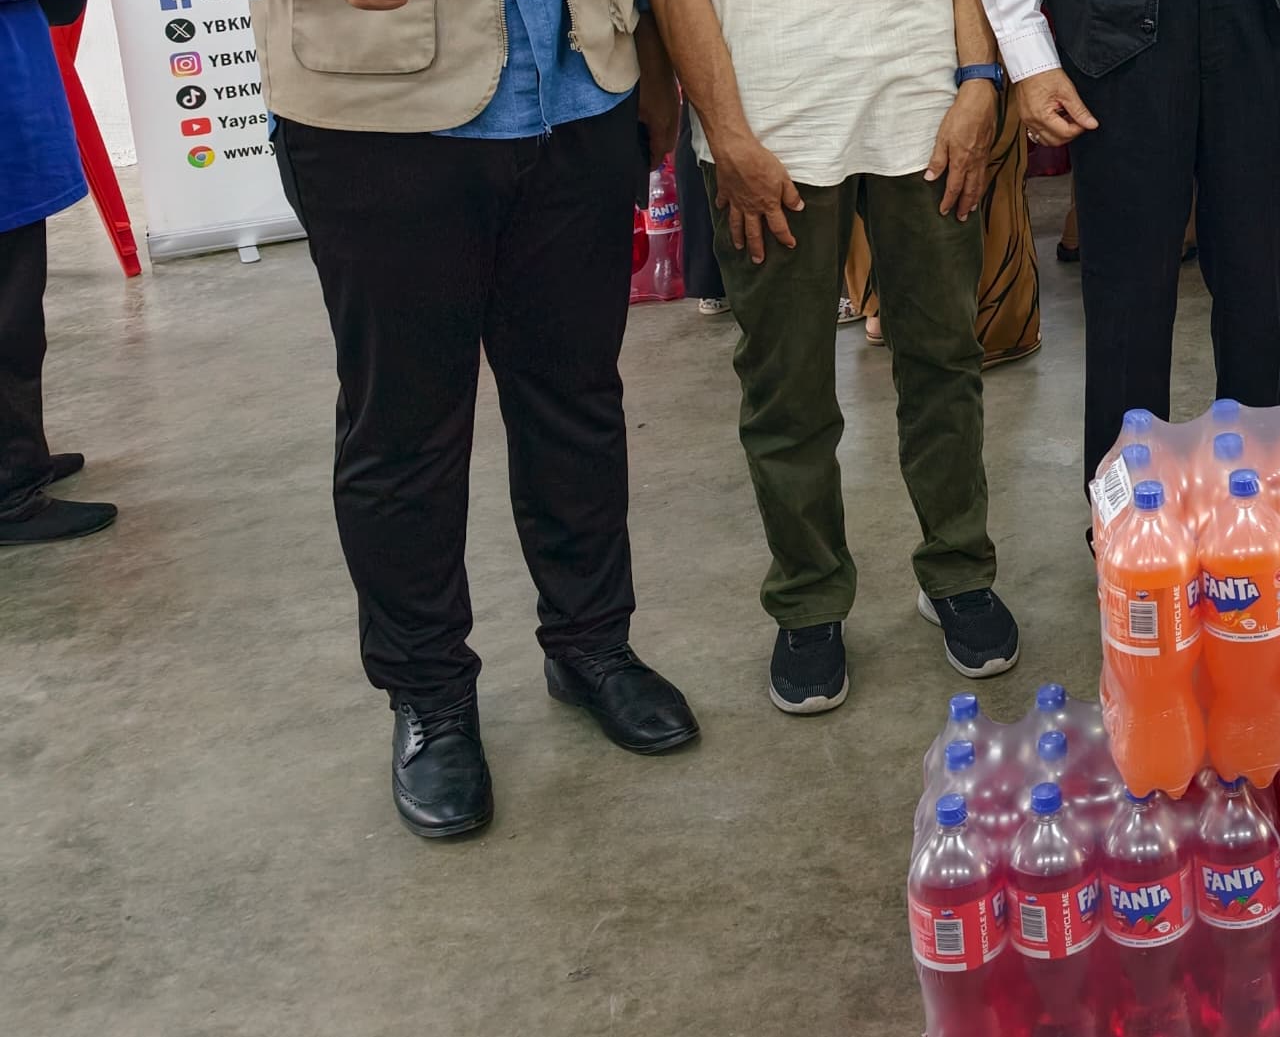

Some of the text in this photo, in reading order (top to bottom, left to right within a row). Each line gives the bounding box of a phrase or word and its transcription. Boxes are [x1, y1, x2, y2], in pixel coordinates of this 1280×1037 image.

[203, 16, 251, 34] YBKM
[209, 49, 259, 67] YBKM
[214, 82, 262, 100] YBKM
[218, 113, 268, 130] Yayas
[224, 143, 276, 160] www.y
[1202, 571, 1260, 601] FANTA
[1202, 866, 1264, 892] FANTA
[1109, 884, 1172, 910] FANTA
